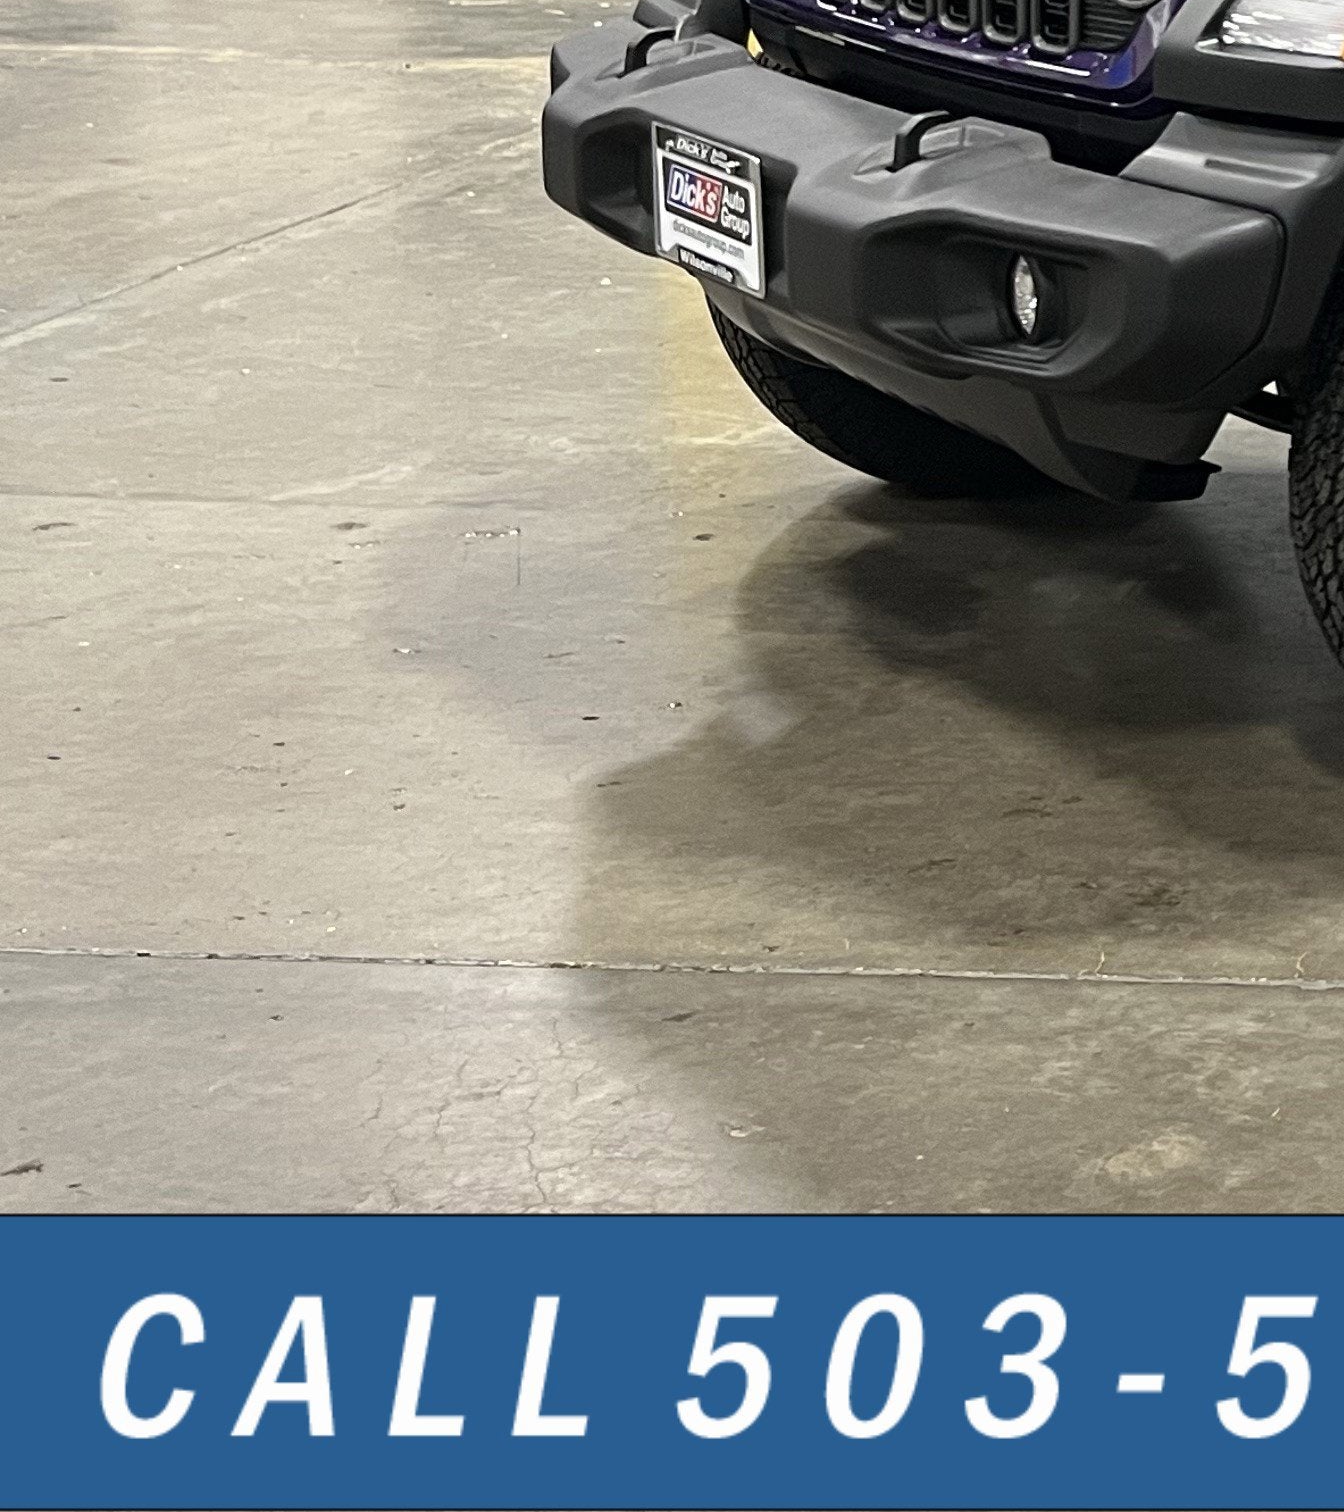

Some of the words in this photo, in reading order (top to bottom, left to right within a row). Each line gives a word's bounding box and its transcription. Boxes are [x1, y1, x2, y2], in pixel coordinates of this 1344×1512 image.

[670, 171, 718, 220] Dick's
[722, 185, 746, 214] Auto
[720, 206, 751, 240] Group
